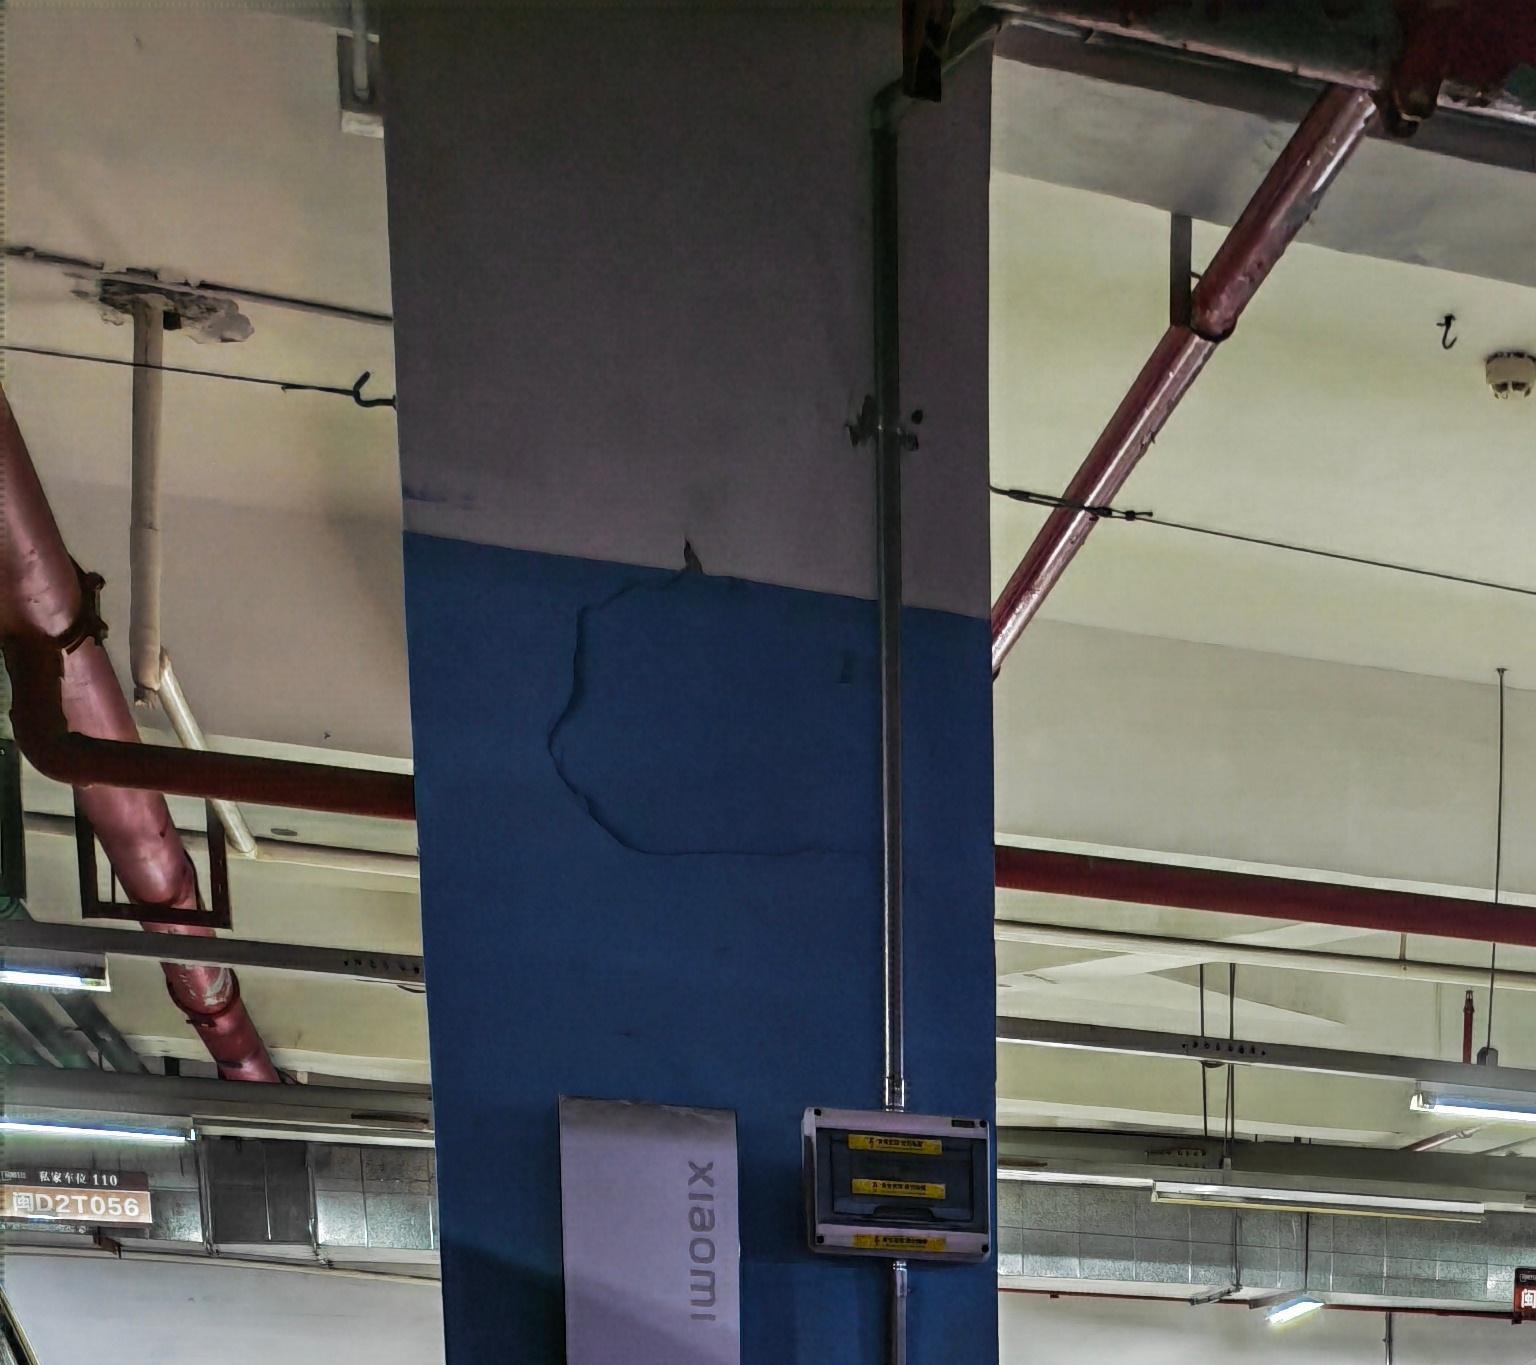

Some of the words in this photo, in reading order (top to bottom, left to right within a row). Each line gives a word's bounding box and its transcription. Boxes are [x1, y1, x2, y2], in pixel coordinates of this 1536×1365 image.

[92, 1174, 118, 1186] 110
[12, 1191, 140, 1217] 闽D2T056
[687, 1160, 716, 1322] xiaomi
